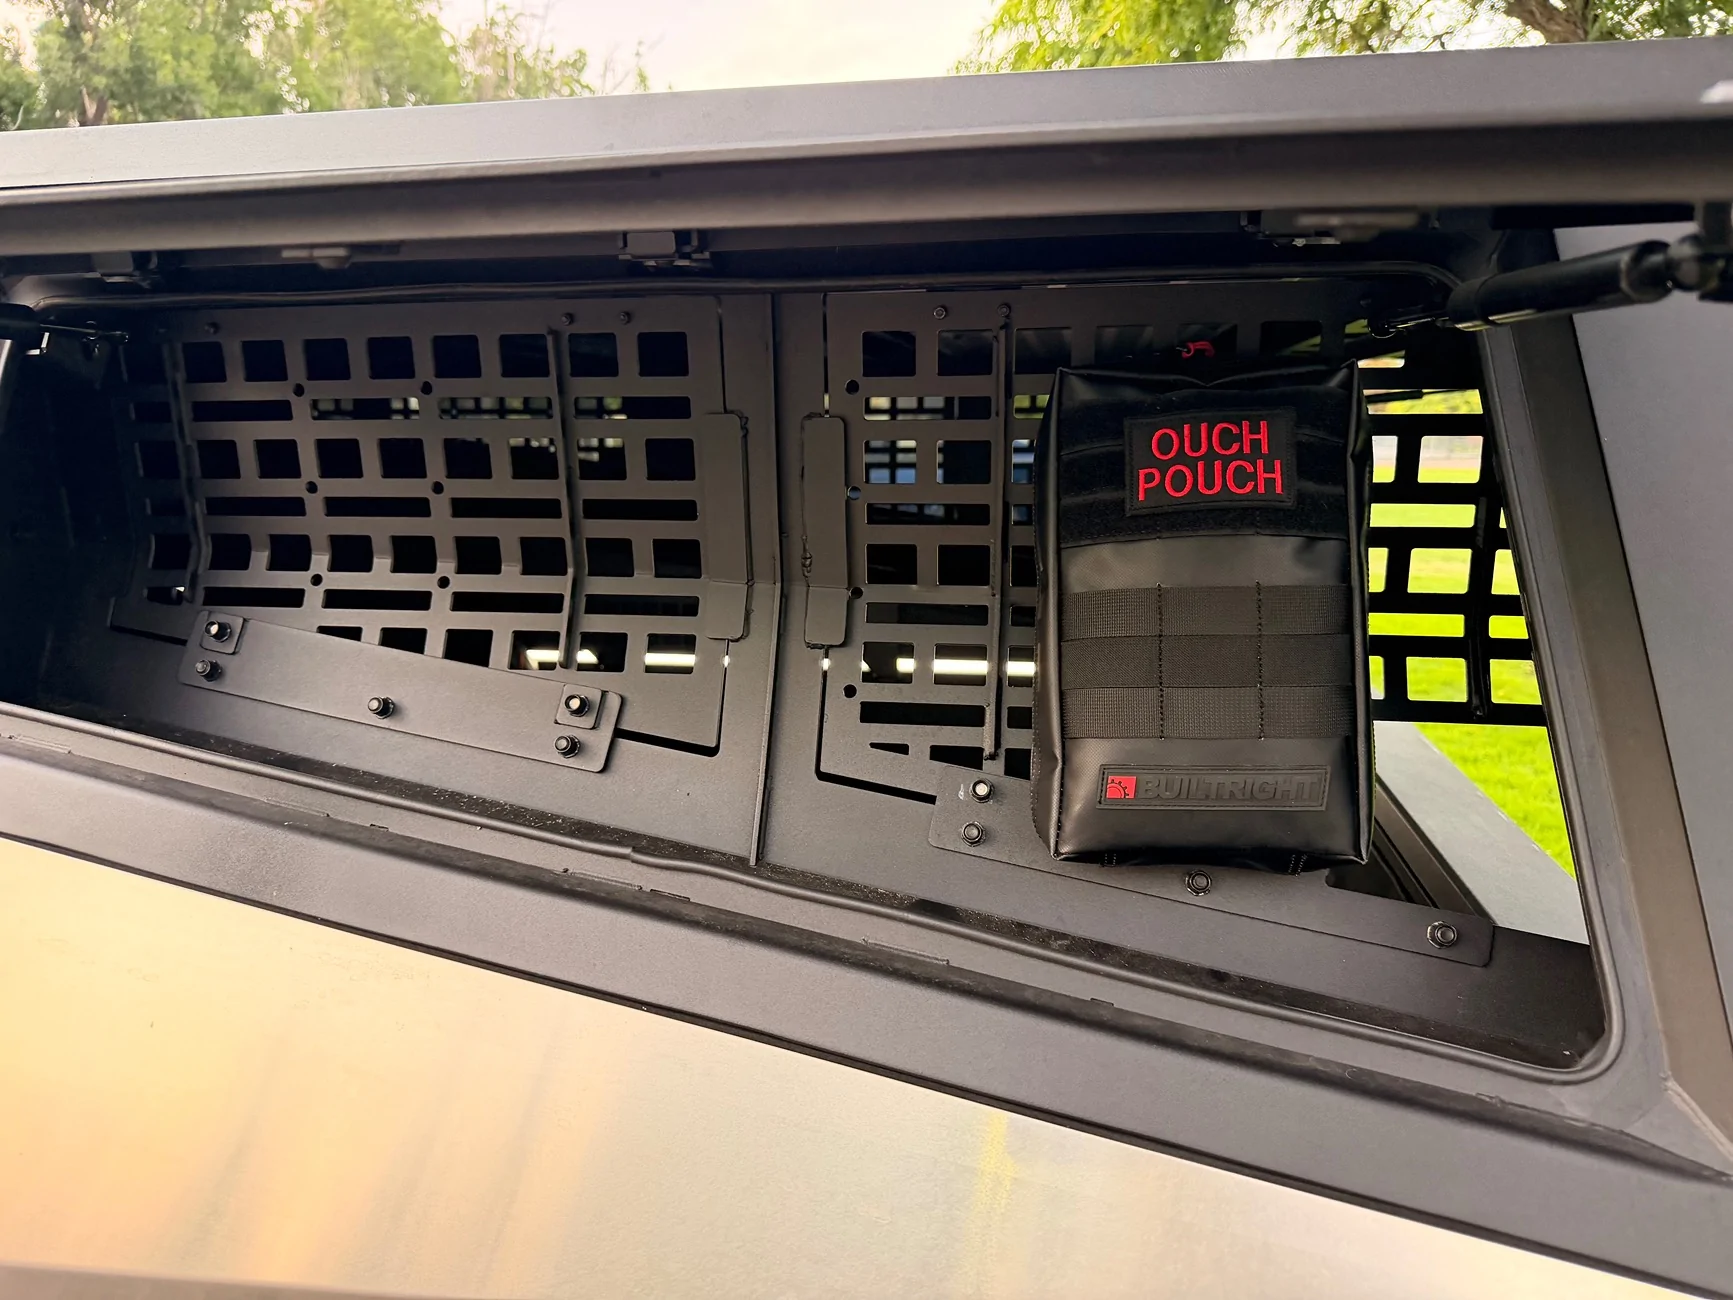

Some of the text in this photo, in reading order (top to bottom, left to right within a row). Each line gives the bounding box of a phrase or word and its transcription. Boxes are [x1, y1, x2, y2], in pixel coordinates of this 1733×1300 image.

[1151, 419, 1270, 461] OUCH
[1137, 458, 1284, 502] POUCH
[1140, 776, 1318, 799] BUILTRIGHT
